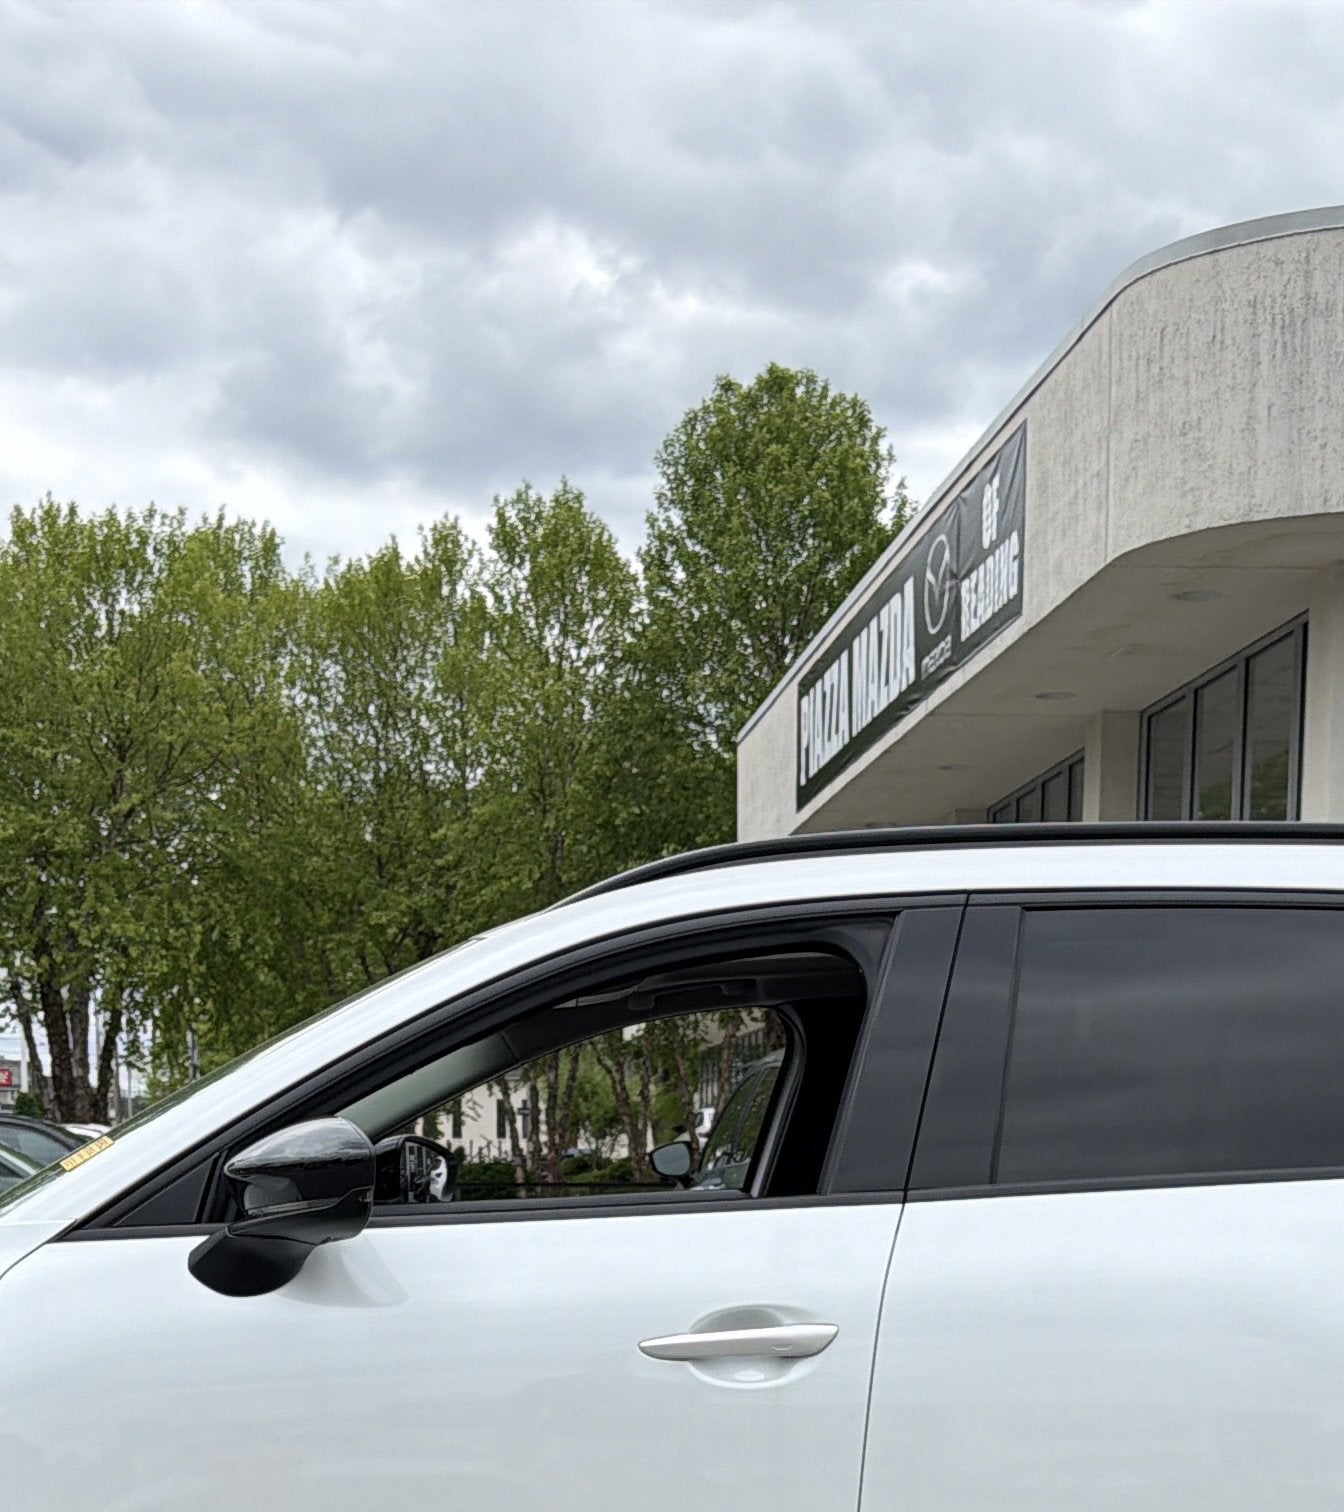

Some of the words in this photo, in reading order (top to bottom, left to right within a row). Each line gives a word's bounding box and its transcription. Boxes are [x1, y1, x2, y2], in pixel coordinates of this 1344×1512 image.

[960, 530, 1020, 643] READING
[799, 648, 851, 788] PIAZZA
[851, 575, 917, 739] MAZDA
